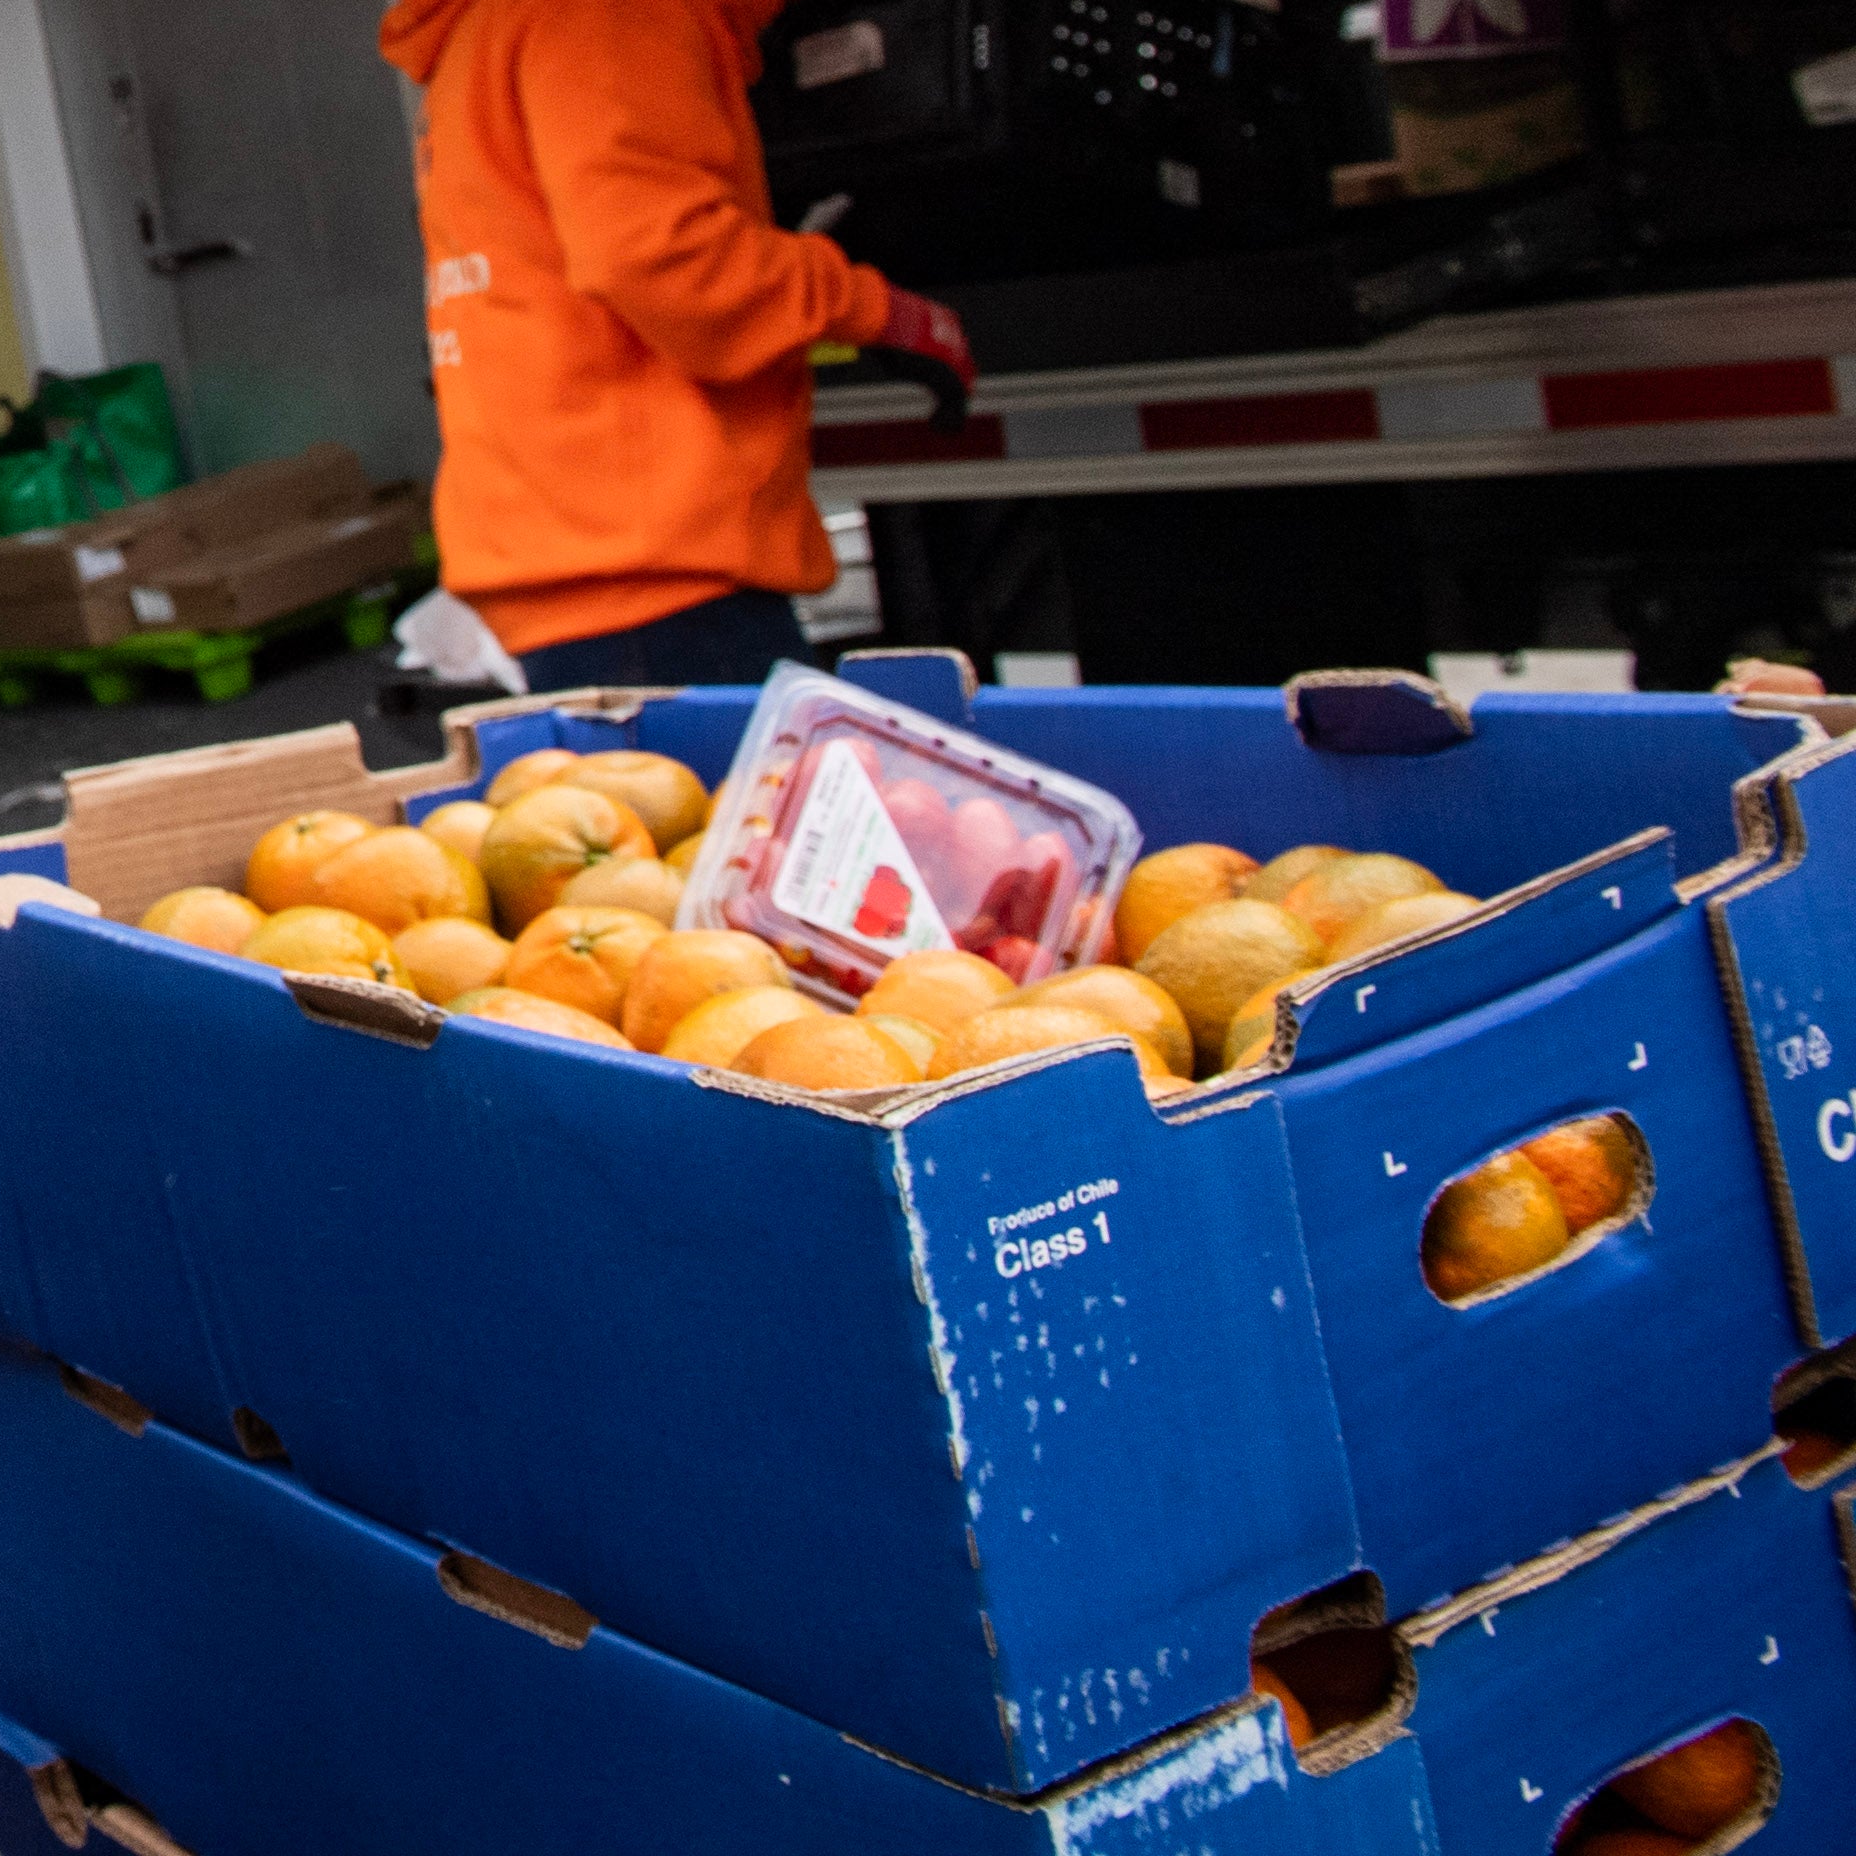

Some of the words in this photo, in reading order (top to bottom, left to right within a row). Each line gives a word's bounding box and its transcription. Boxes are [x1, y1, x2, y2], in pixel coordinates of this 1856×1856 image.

[987, 1202, 1056, 1236] Produce
[1057, 1190, 1076, 1212] of
[1076, 1178, 1119, 1205] Chile
[995, 1227, 1087, 1279] Class
[1092, 1211, 1110, 1244] 1
